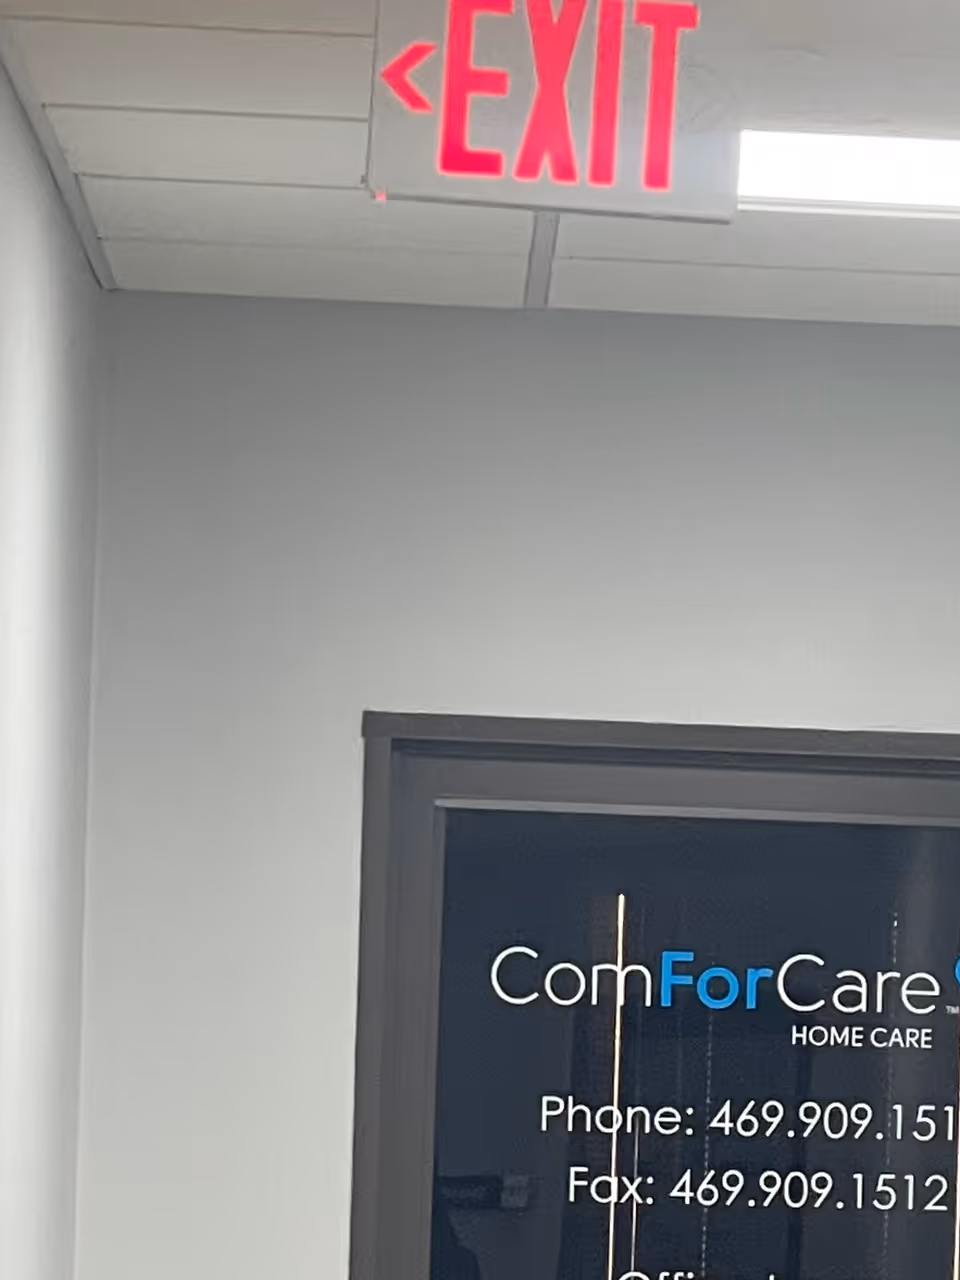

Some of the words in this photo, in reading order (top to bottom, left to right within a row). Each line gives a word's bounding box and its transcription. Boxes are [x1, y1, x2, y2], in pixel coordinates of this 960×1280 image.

[437, 0, 700, 192] EXIT
[490, 946, 941, 1015] ComForCare
[791, 1024, 864, 1047] HOME
[870, 1027, 933, 1049] CARE
[541, 1095, 694, 1136] Phone:
[568, 1166, 654, 1205] Fax:
[669, 1168, 948, 1211] 469.909.1512
